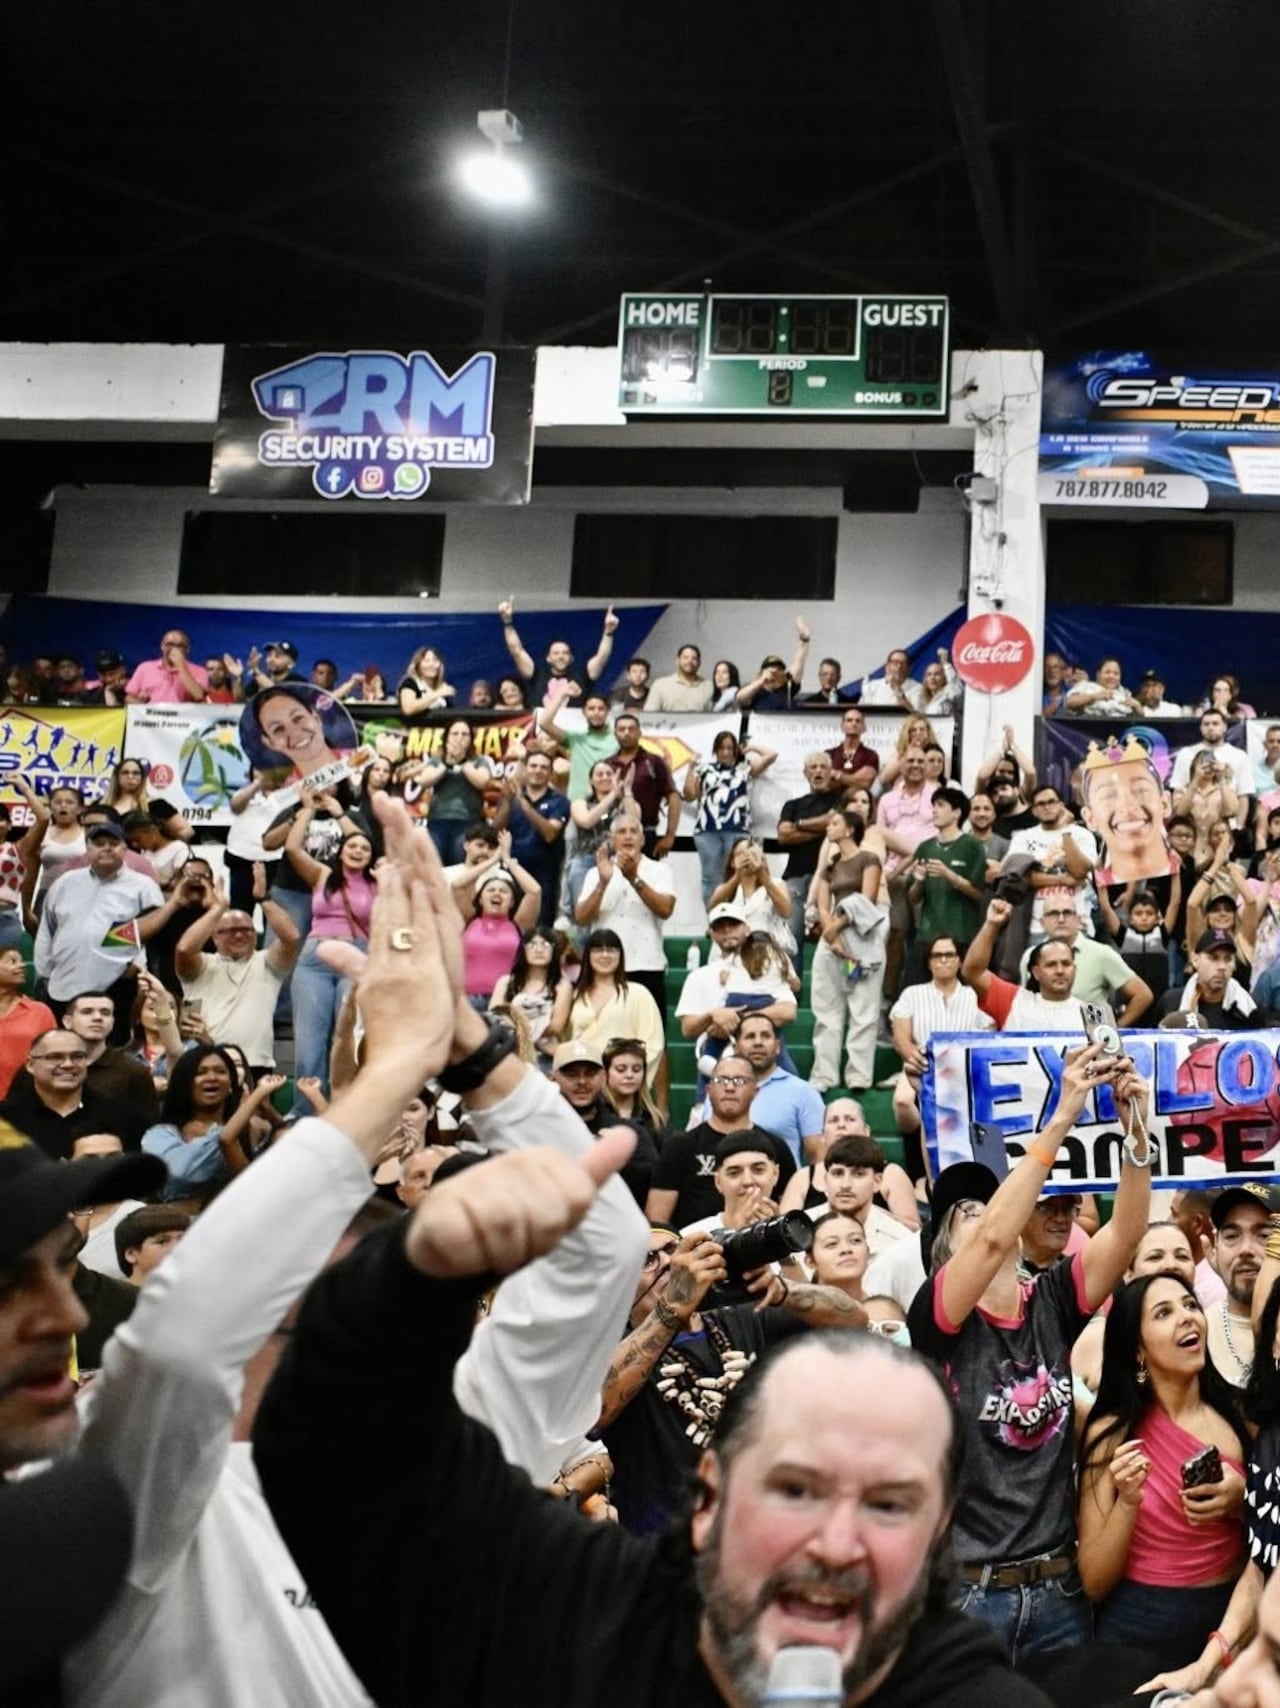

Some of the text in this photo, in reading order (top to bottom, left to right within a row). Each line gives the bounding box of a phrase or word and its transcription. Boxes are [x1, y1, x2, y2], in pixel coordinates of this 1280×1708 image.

[626, 302, 700, 326] HOME
[862, 303, 944, 327] GUEST
[758, 360, 807, 371] PERIOD
[854, 391, 902, 404] BONUS
[264, 434, 488, 462] SECURITY SYSTEM
[1055, 480, 1168, 500] 787.877.8042
[959, 639, 1027, 665] Coca-Cola
